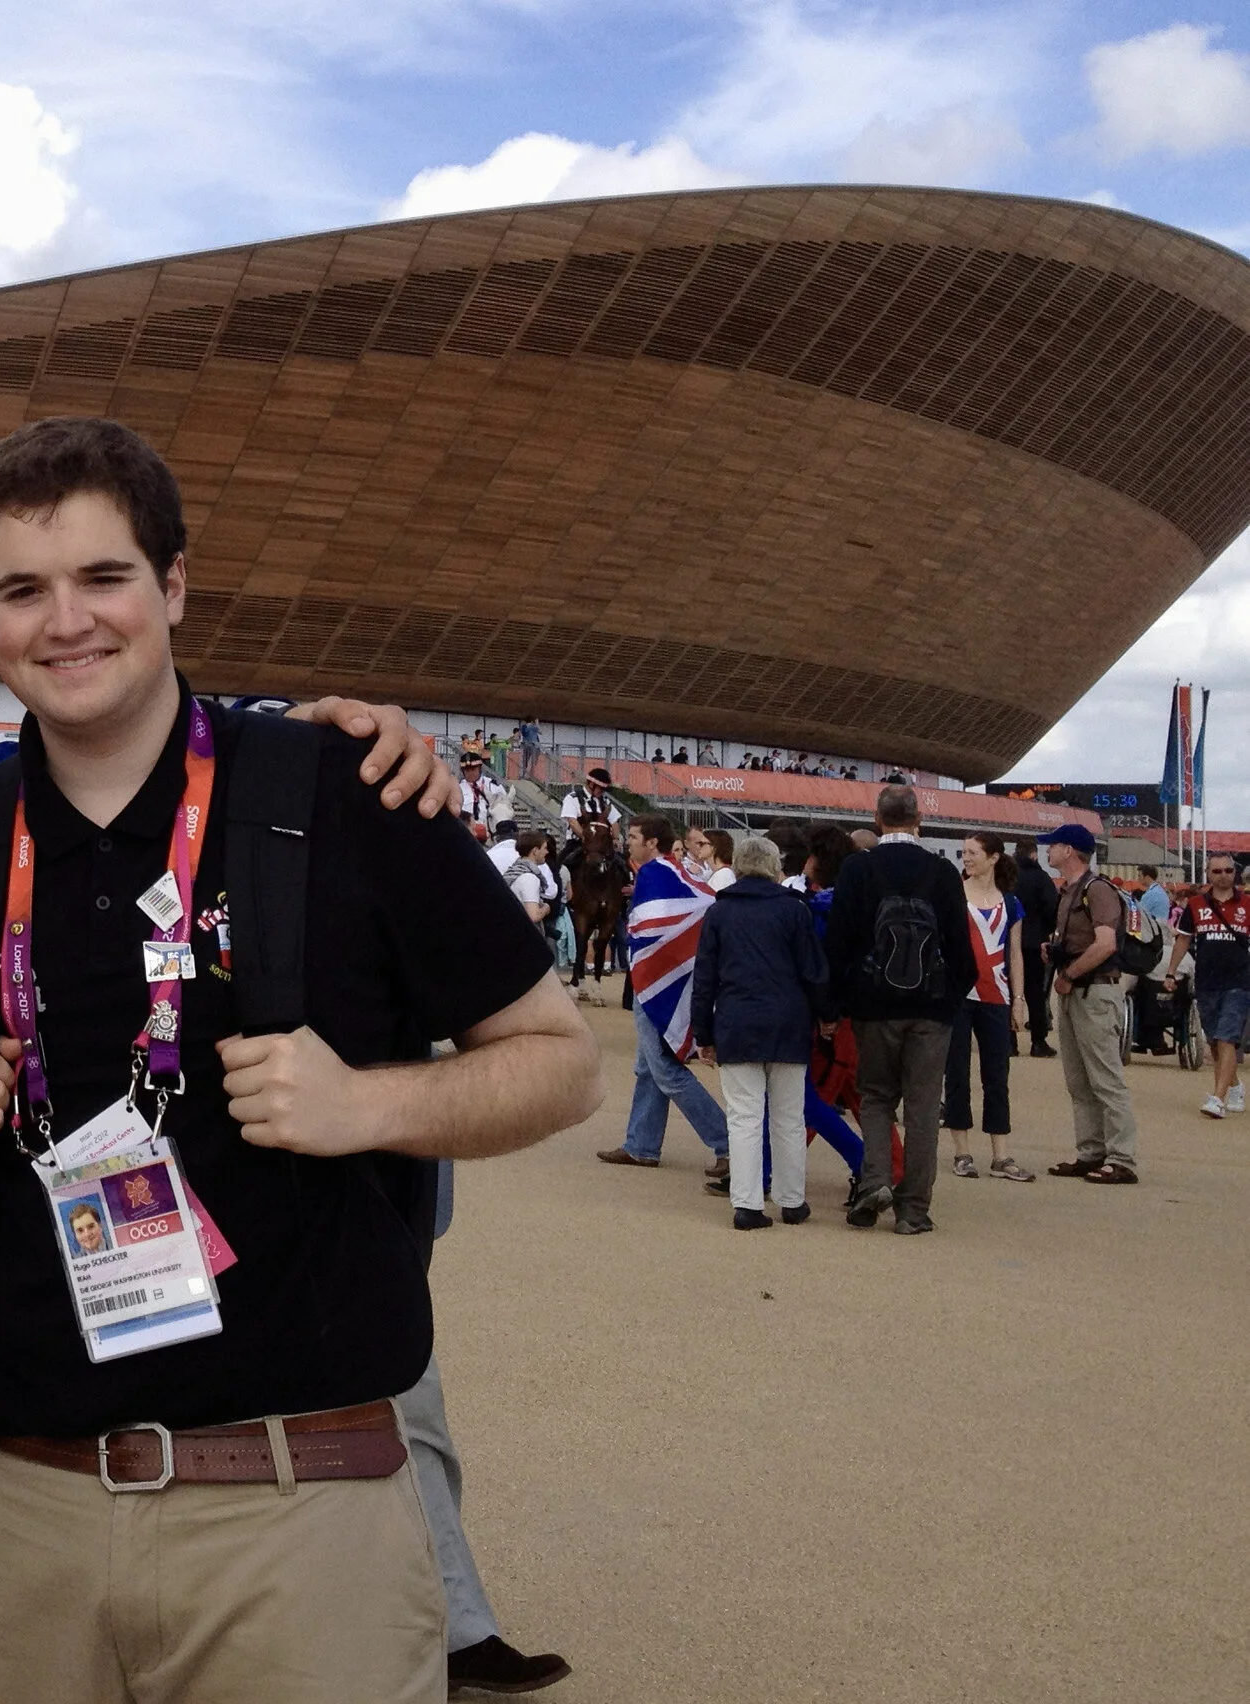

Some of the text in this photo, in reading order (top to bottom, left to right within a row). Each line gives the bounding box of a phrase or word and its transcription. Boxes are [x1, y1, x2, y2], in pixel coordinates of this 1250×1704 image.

[691, 774, 745, 791] London 2012
[1094, 794, 1137, 807] 15:30
[187, 805, 200, 840] Atos
[18, 836, 30, 868] Atos
[1198, 908, 1212, 920] 12
[18, 992, 30, 1020] 2012
[129, 1219, 169, 1240] OCOG
